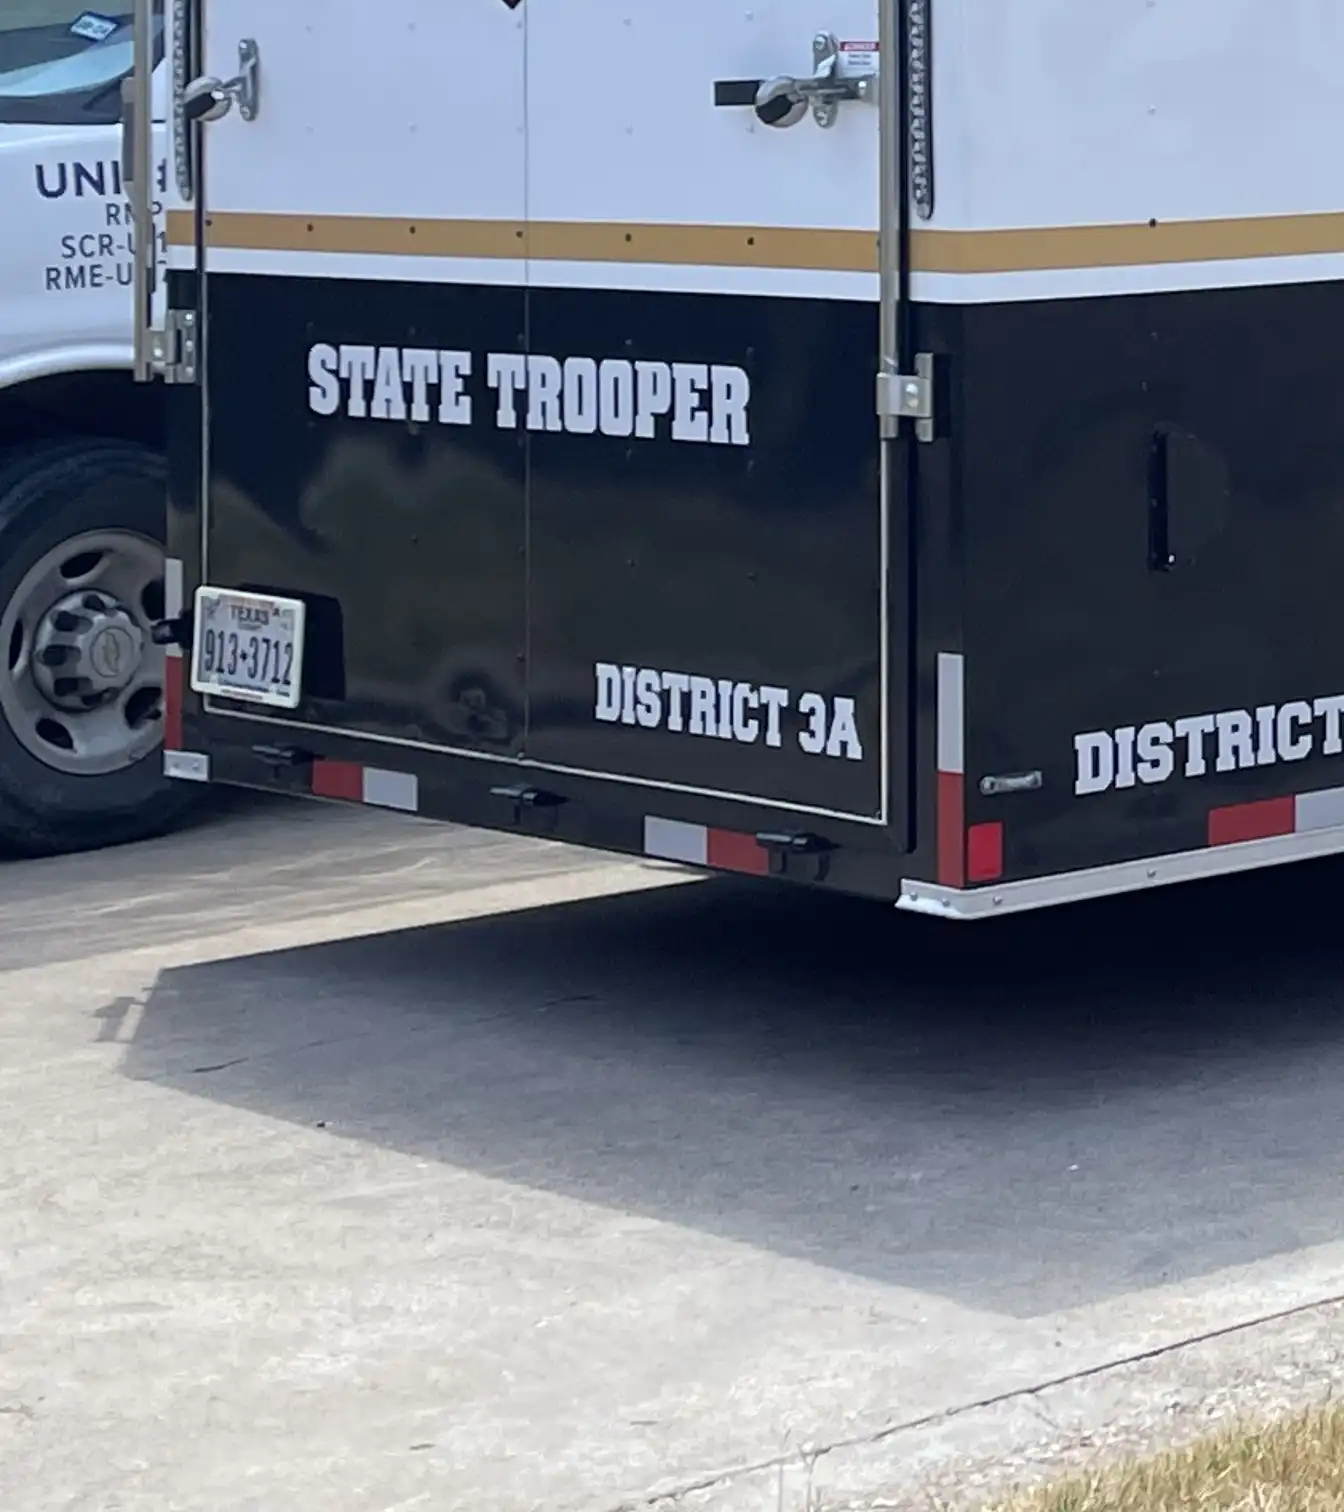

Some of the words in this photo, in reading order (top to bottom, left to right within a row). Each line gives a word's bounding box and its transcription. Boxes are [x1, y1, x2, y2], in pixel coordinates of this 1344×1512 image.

[307, 342, 472, 426] STATE
[486, 352, 750, 446] TROOPER
[231, 604, 270, 626] TEXAS
[595, 662, 789, 748] DISTRICT
[798, 691, 863, 760] 3A
